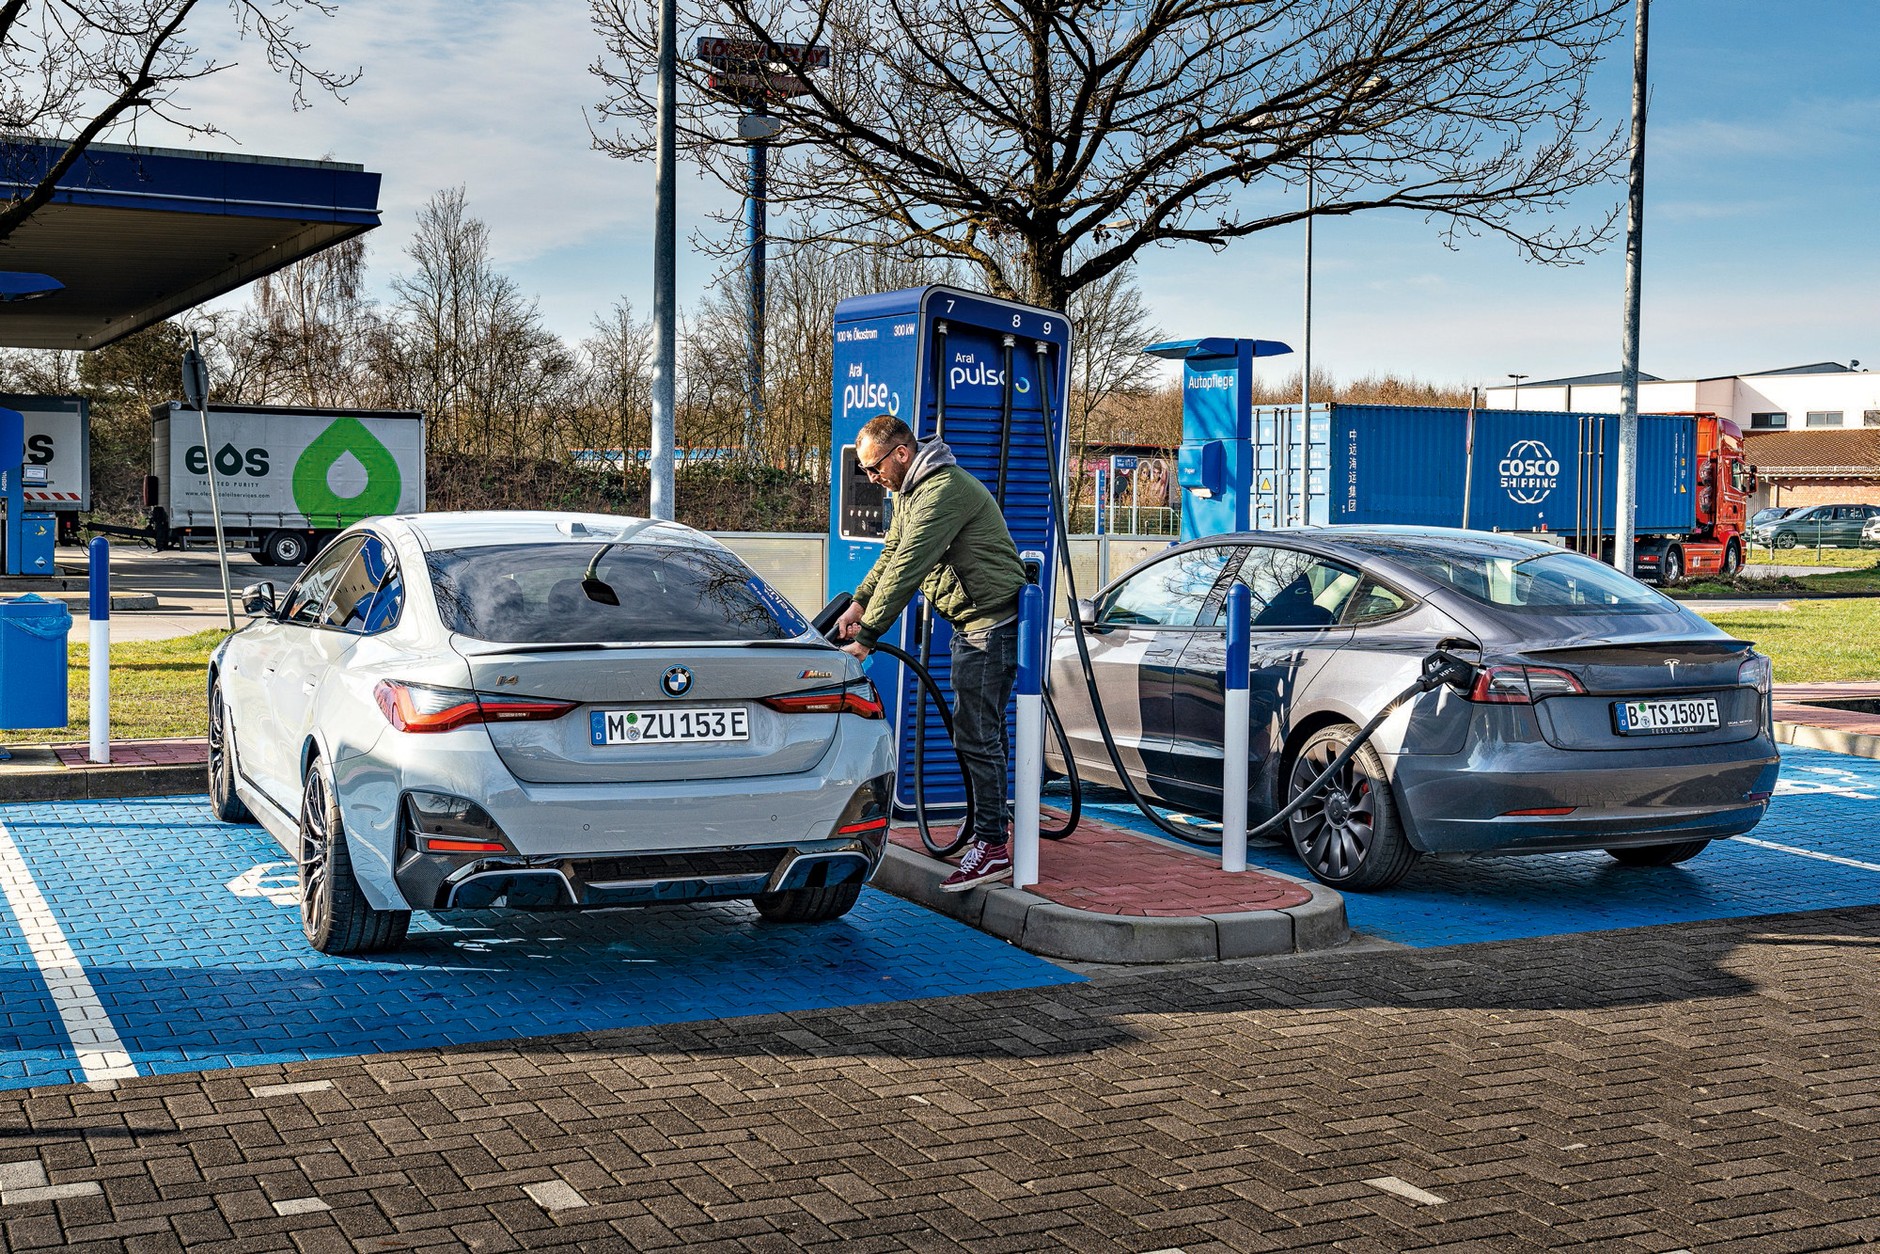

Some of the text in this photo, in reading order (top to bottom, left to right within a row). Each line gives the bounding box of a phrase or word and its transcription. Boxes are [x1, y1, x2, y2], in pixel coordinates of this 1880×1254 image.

[946, 300, 956, 313] 7
[1012, 314, 1021, 328] 8
[1043, 321, 1052, 335] 9
[836, 331, 846, 342] 100
[853, 327, 878, 340] Ökostrom
[893, 323, 916, 336] 300 kW
[955, 352, 975, 364] Aral
[848, 362, 863, 377] Aral
[1188, 373, 1234, 391] Autopflege
[843, 373, 888, 418] pulse
[23, 434, 55, 463] s
[185, 442, 270, 477] eos
[1499, 459, 1560, 476] COSCO
[1500, 477, 1557, 488] SHIPPING
[185, 491, 270, 499] www.eleccaloilservices.com
[1628, 706, 1638, 727] B
[608, 715, 625, 740] M
[1651, 727, 1695, 735] TESLA.COM
[595, 732, 602, 740] D
